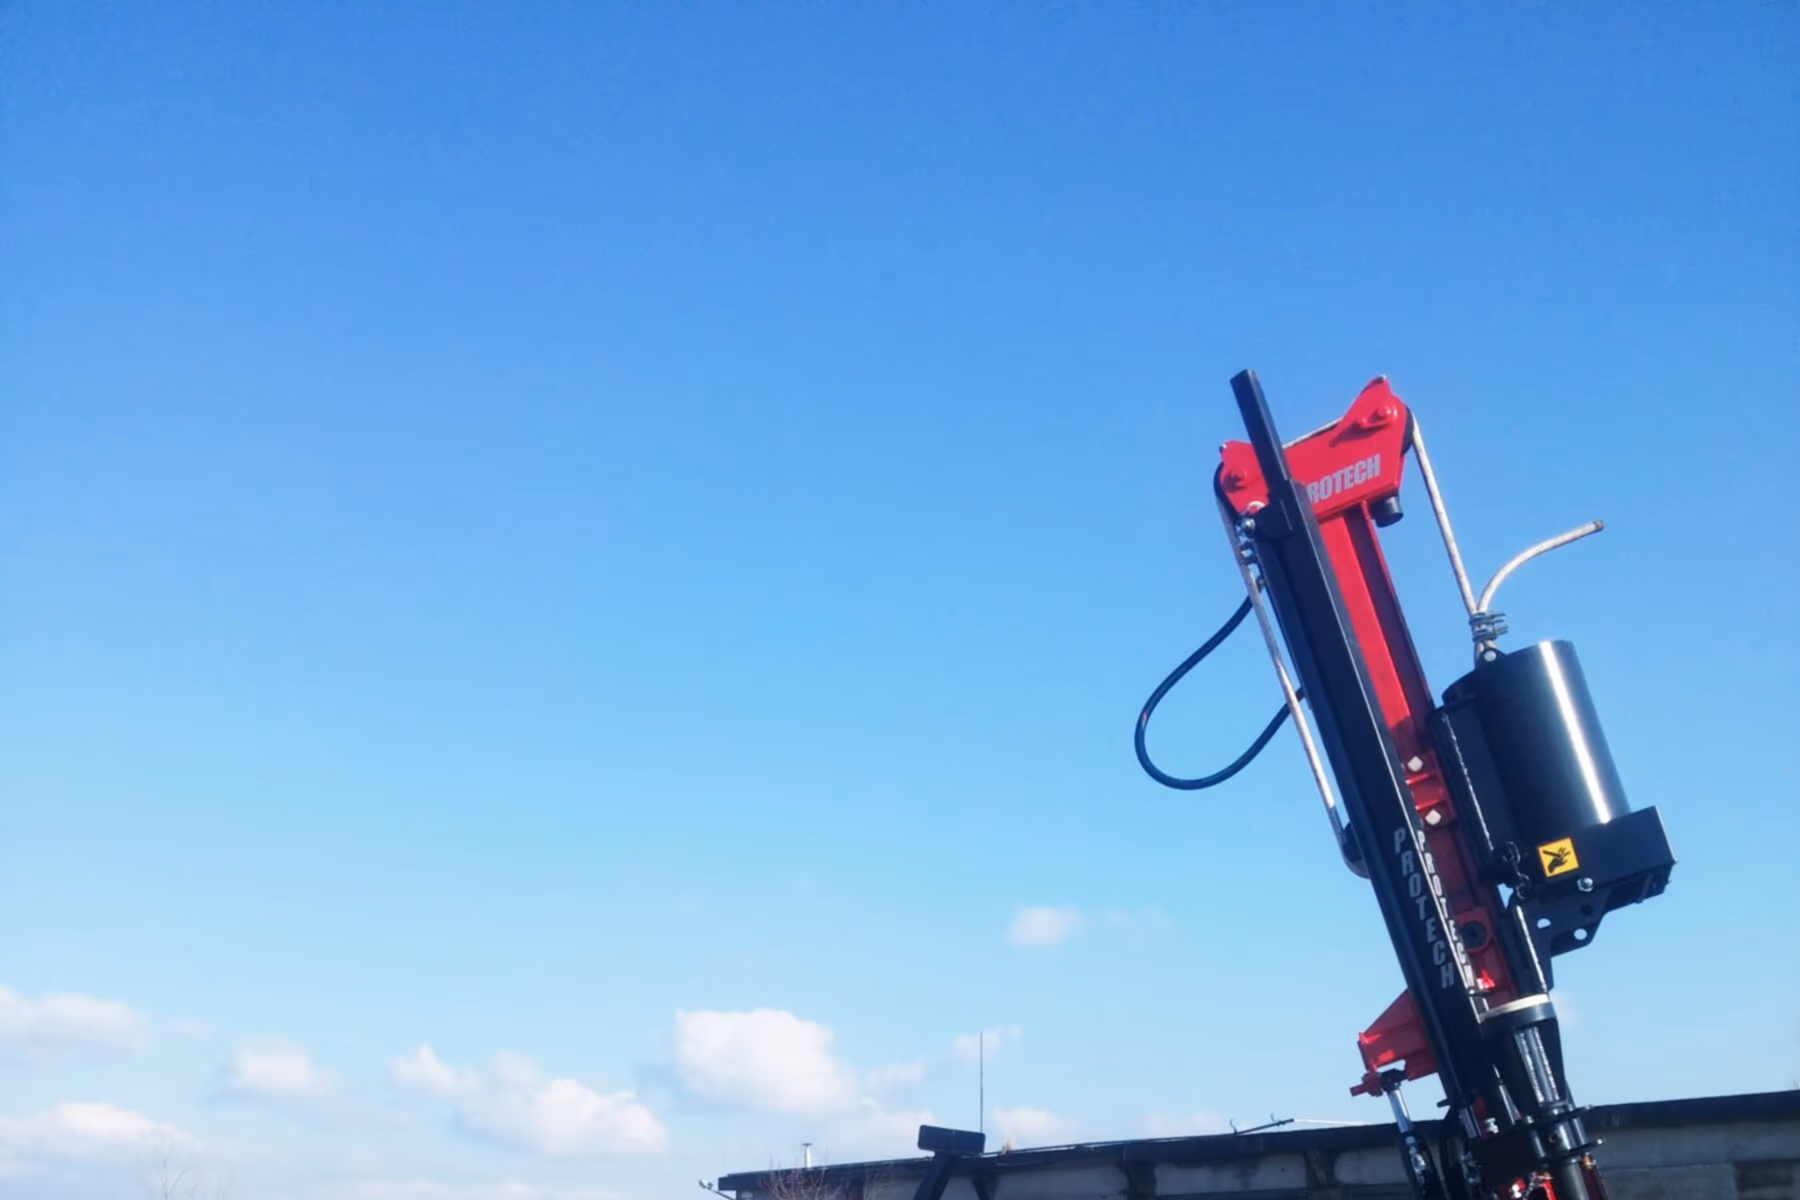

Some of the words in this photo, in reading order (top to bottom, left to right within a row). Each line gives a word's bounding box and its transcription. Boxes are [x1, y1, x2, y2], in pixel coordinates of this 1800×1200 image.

[1306, 453, 1381, 504] ROTECH
[1393, 827, 1455, 989] PROTECH
[1417, 830, 1475, 987] PROTECH
